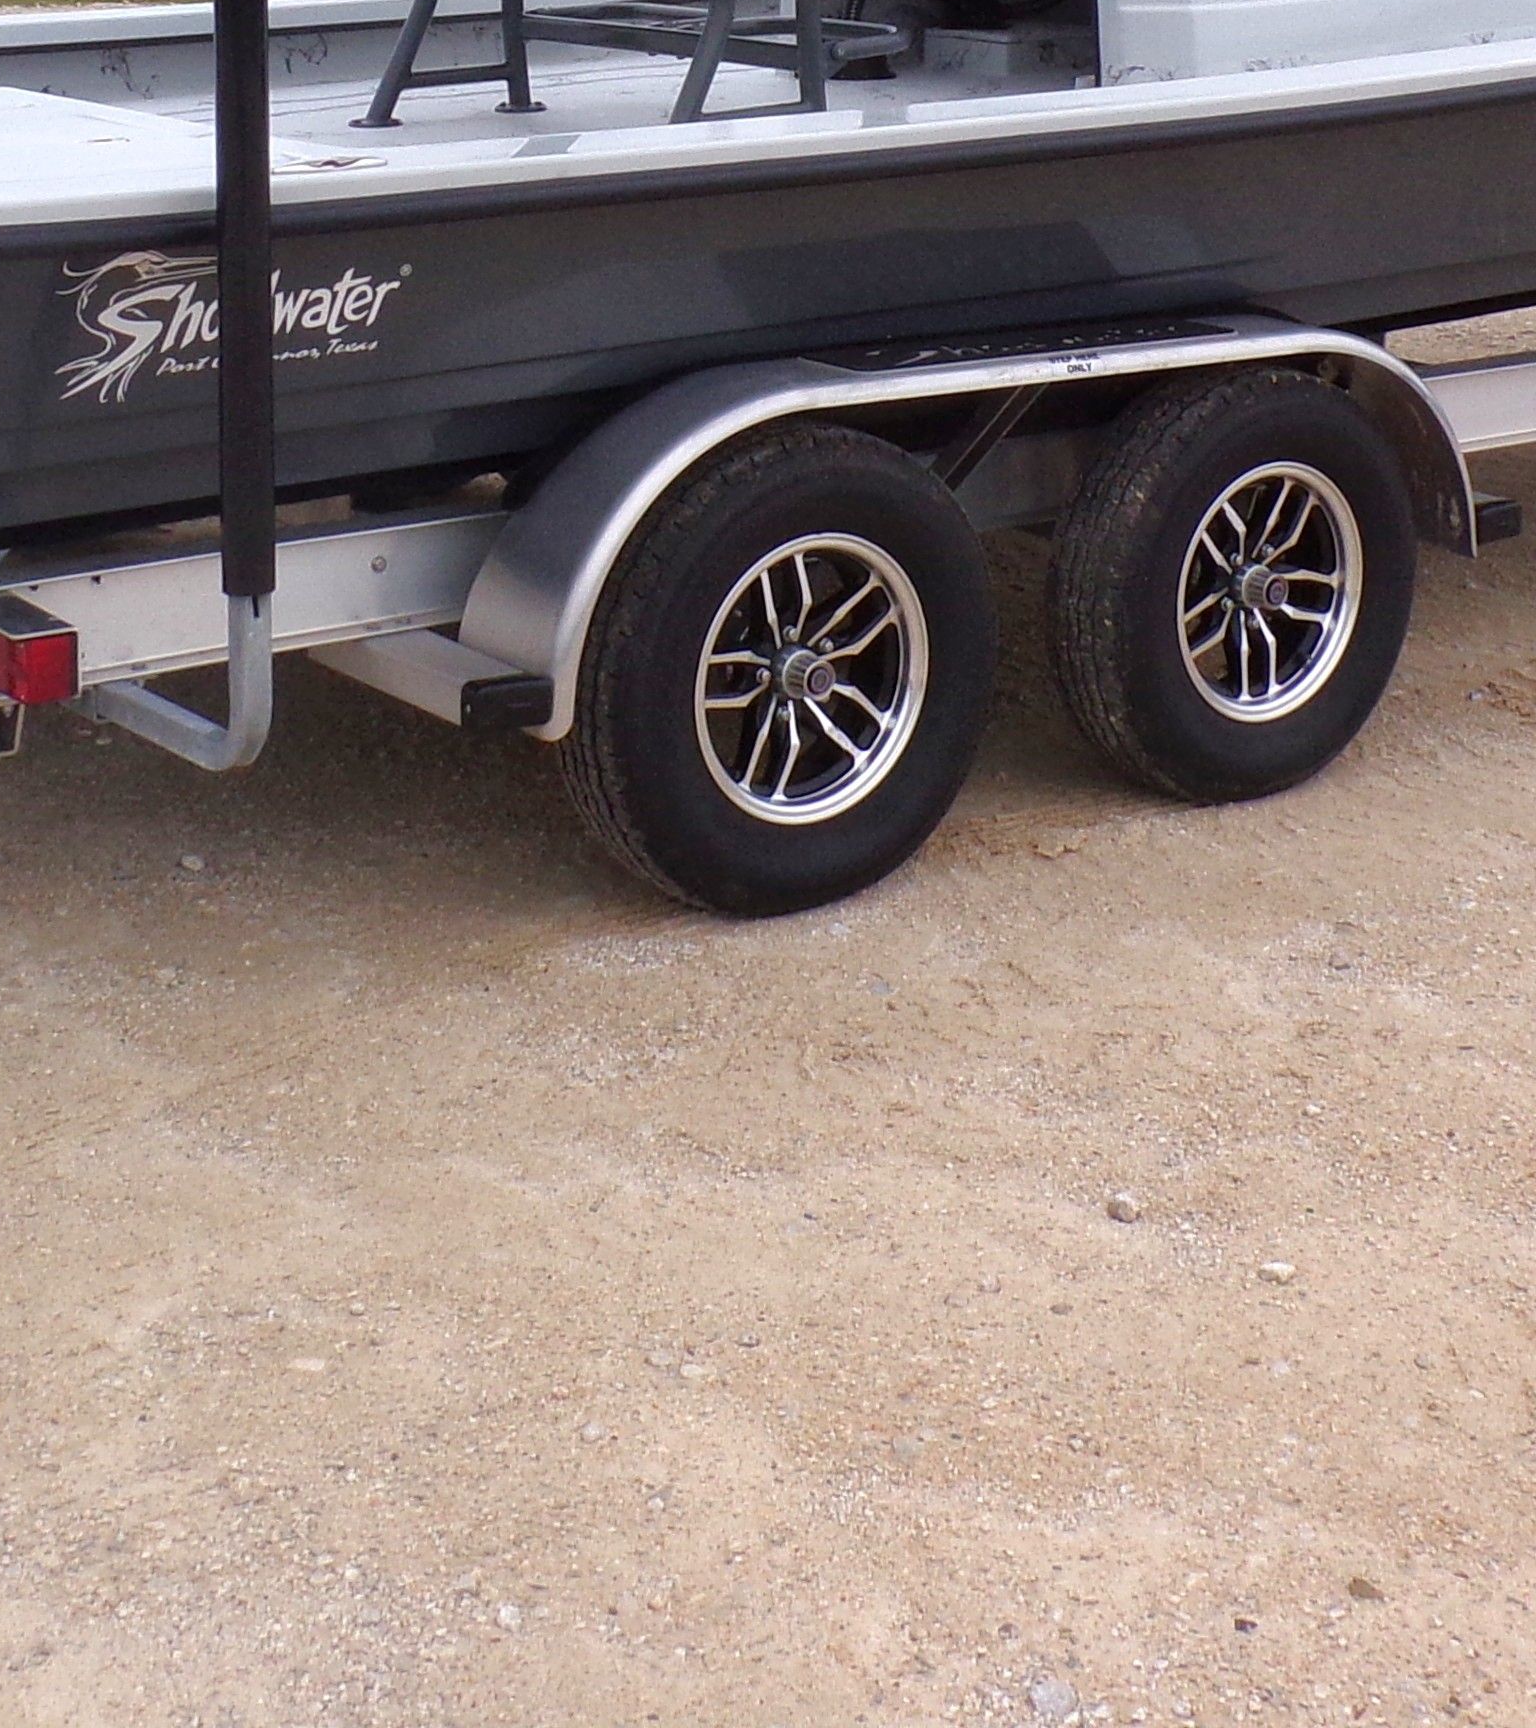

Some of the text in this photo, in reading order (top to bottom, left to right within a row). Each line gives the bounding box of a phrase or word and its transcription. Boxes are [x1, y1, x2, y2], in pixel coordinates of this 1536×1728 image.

[156, 355, 210, 376] Port
[326, 337, 378, 356] Texas
[1067, 362, 1092, 373] ONLY
